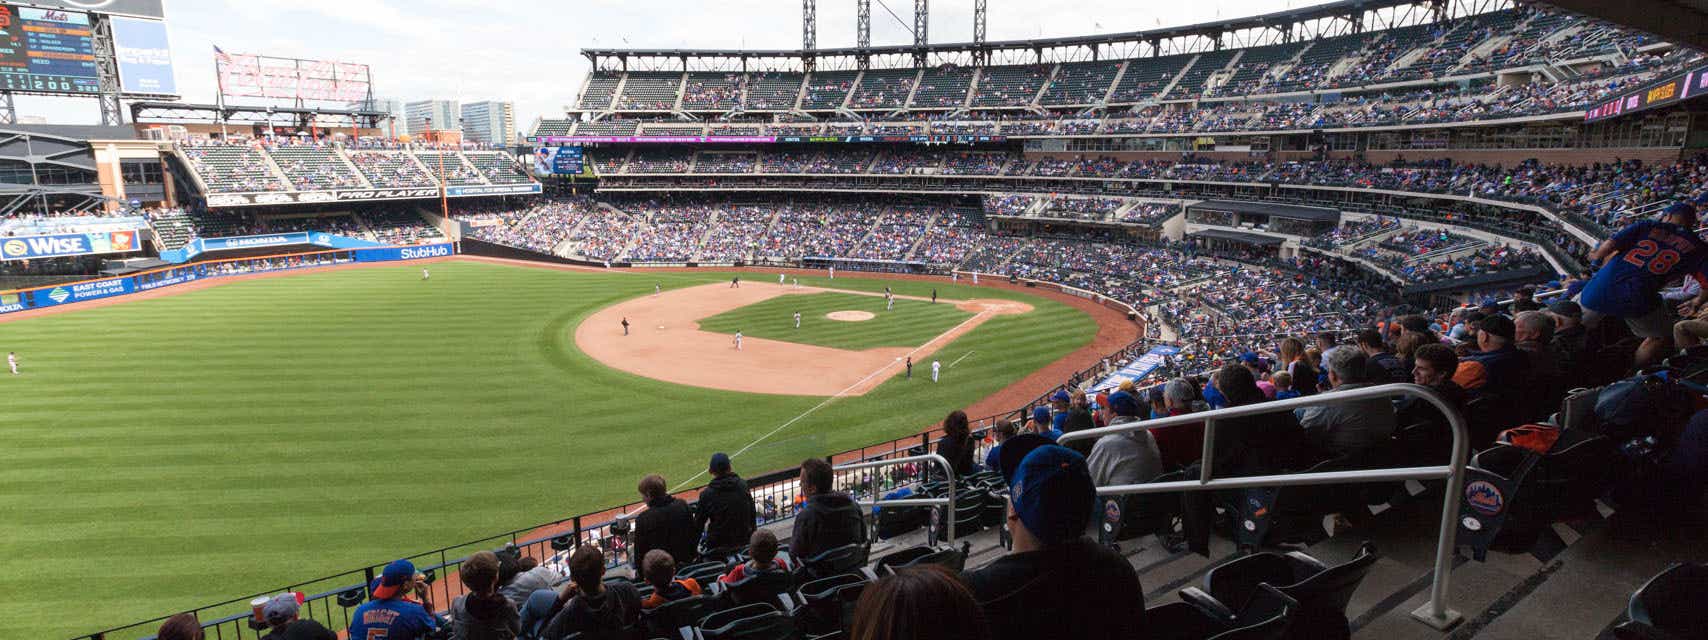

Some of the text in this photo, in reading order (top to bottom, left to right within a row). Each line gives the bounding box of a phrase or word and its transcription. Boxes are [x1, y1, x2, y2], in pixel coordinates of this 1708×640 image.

[338, 190, 373, 199] PRO
[375, 189, 437, 198] PLAYER
[28, 237, 87, 255] WISE
[401, 245, 448, 259] StubHub
[1623, 240, 1680, 274] 28
[73, 279, 122, 291] EAST COAST
[74, 289, 102, 298] POWER
